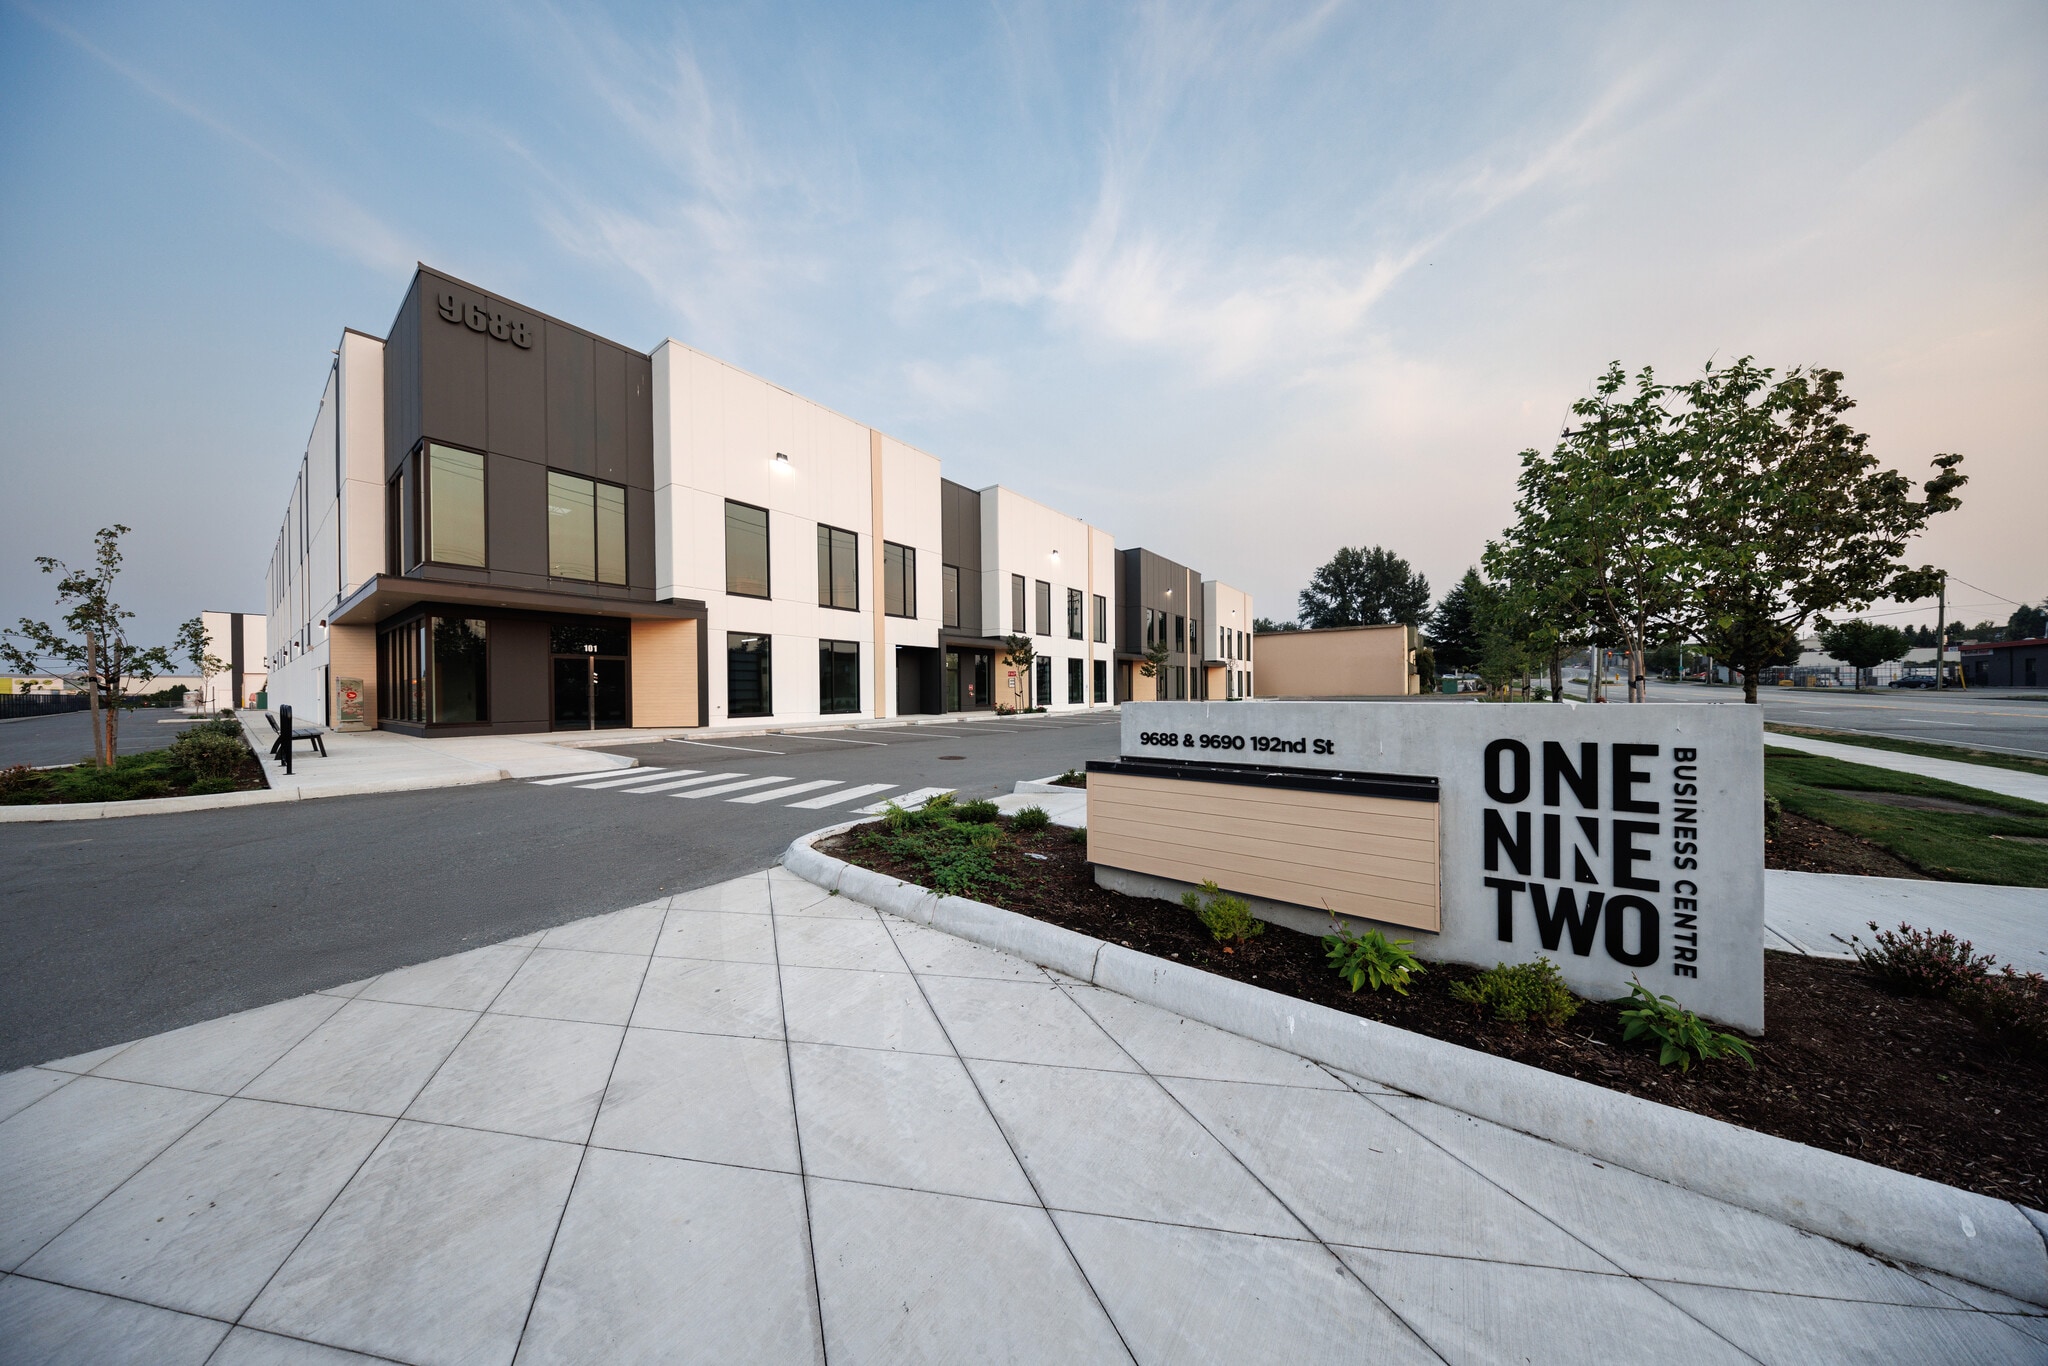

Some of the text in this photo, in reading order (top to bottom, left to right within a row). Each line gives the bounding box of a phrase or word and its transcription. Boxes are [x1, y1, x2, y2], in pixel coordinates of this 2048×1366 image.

[438, 289, 532, 349] 9688
[584, 644, 598, 652] 101
[1140, 732, 1334, 754] 9688 & 9690 192nd St
[1484, 738, 1660, 815] ONE
[1484, 807, 1660, 893] NINE
[1673, 747, 1698, 979] BUSINESS CENTRE
[1484, 876, 1660, 968] TWO
